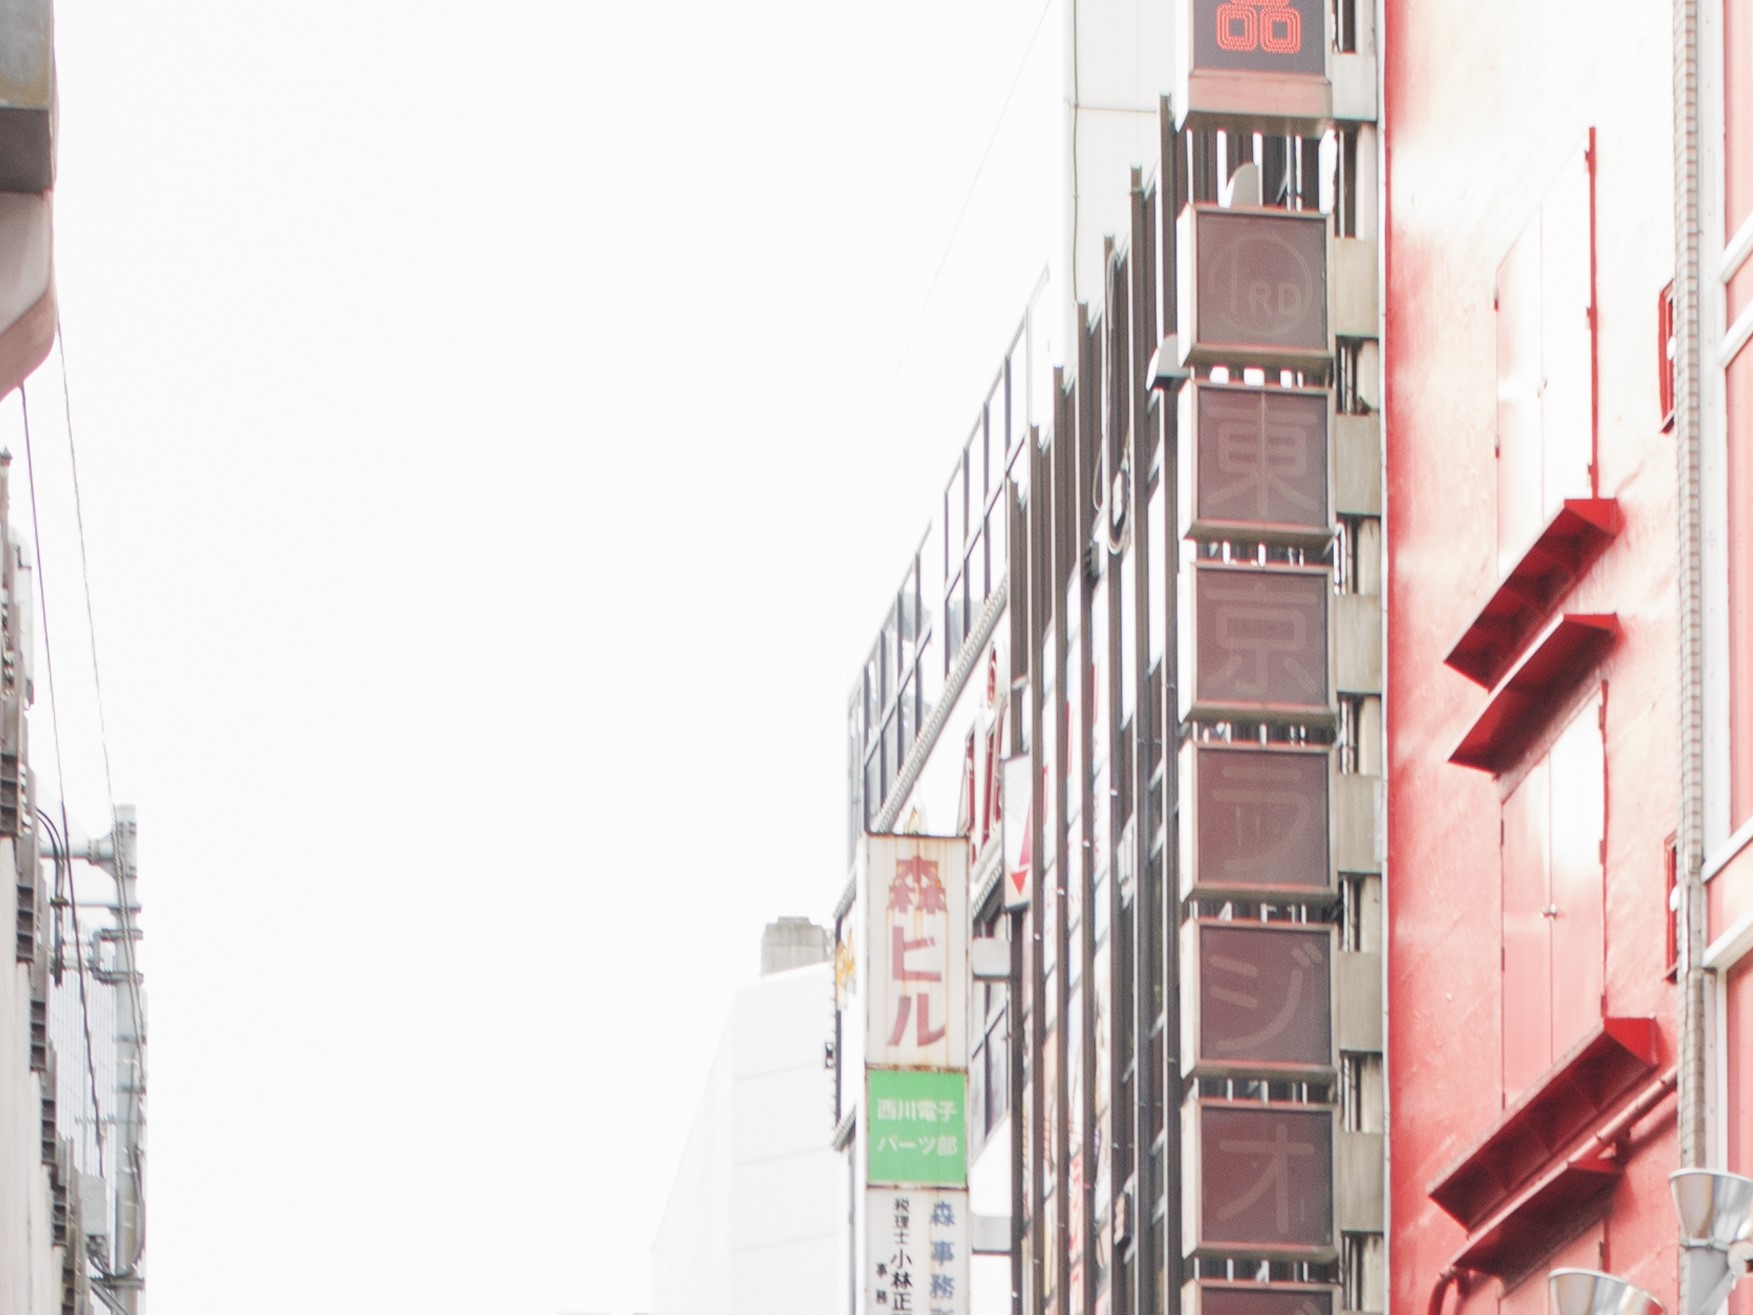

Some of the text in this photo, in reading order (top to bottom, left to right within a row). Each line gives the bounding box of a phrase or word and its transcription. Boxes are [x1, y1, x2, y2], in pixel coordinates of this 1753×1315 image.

[887, 856, 948, 1047] 森ビル
[877, 1099, 957, 1123] 西川電子
[877, 1135, 958, 1156] パーツ部
